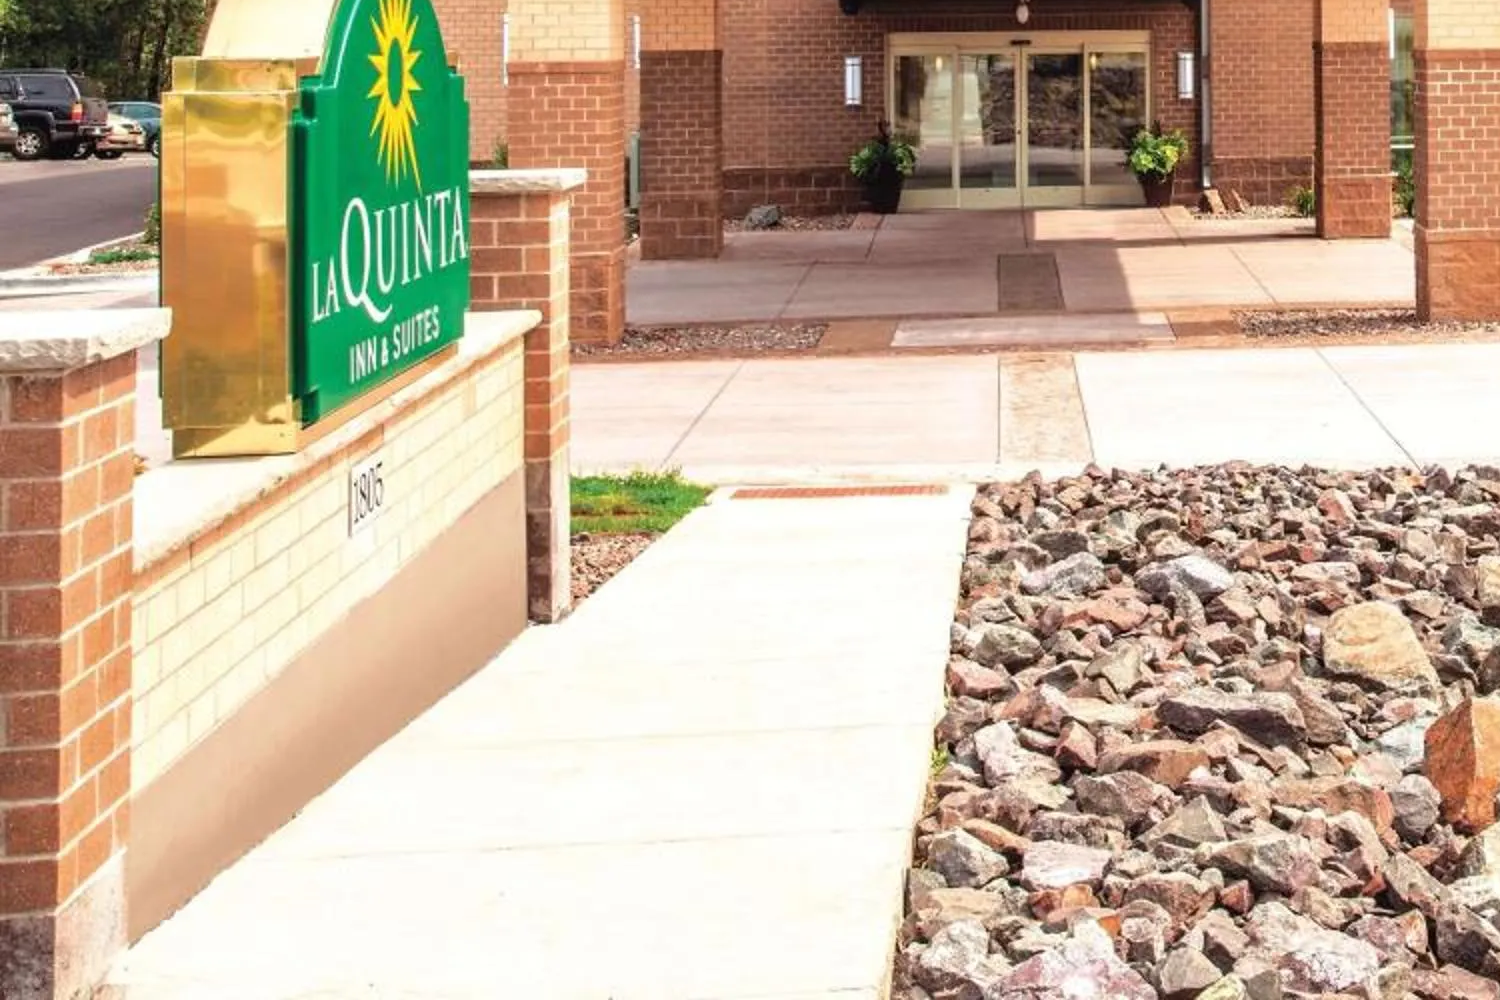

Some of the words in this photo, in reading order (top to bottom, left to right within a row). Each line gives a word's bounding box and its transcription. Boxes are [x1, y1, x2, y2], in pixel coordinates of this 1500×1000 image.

[312, 255, 340, 323] LA
[340, 186, 468, 323] QUINTA
[349, 335, 377, 384] INN
[381, 336, 389, 367] &
[393, 304, 440, 360] SUITES
[353, 461, 385, 523] 1805
